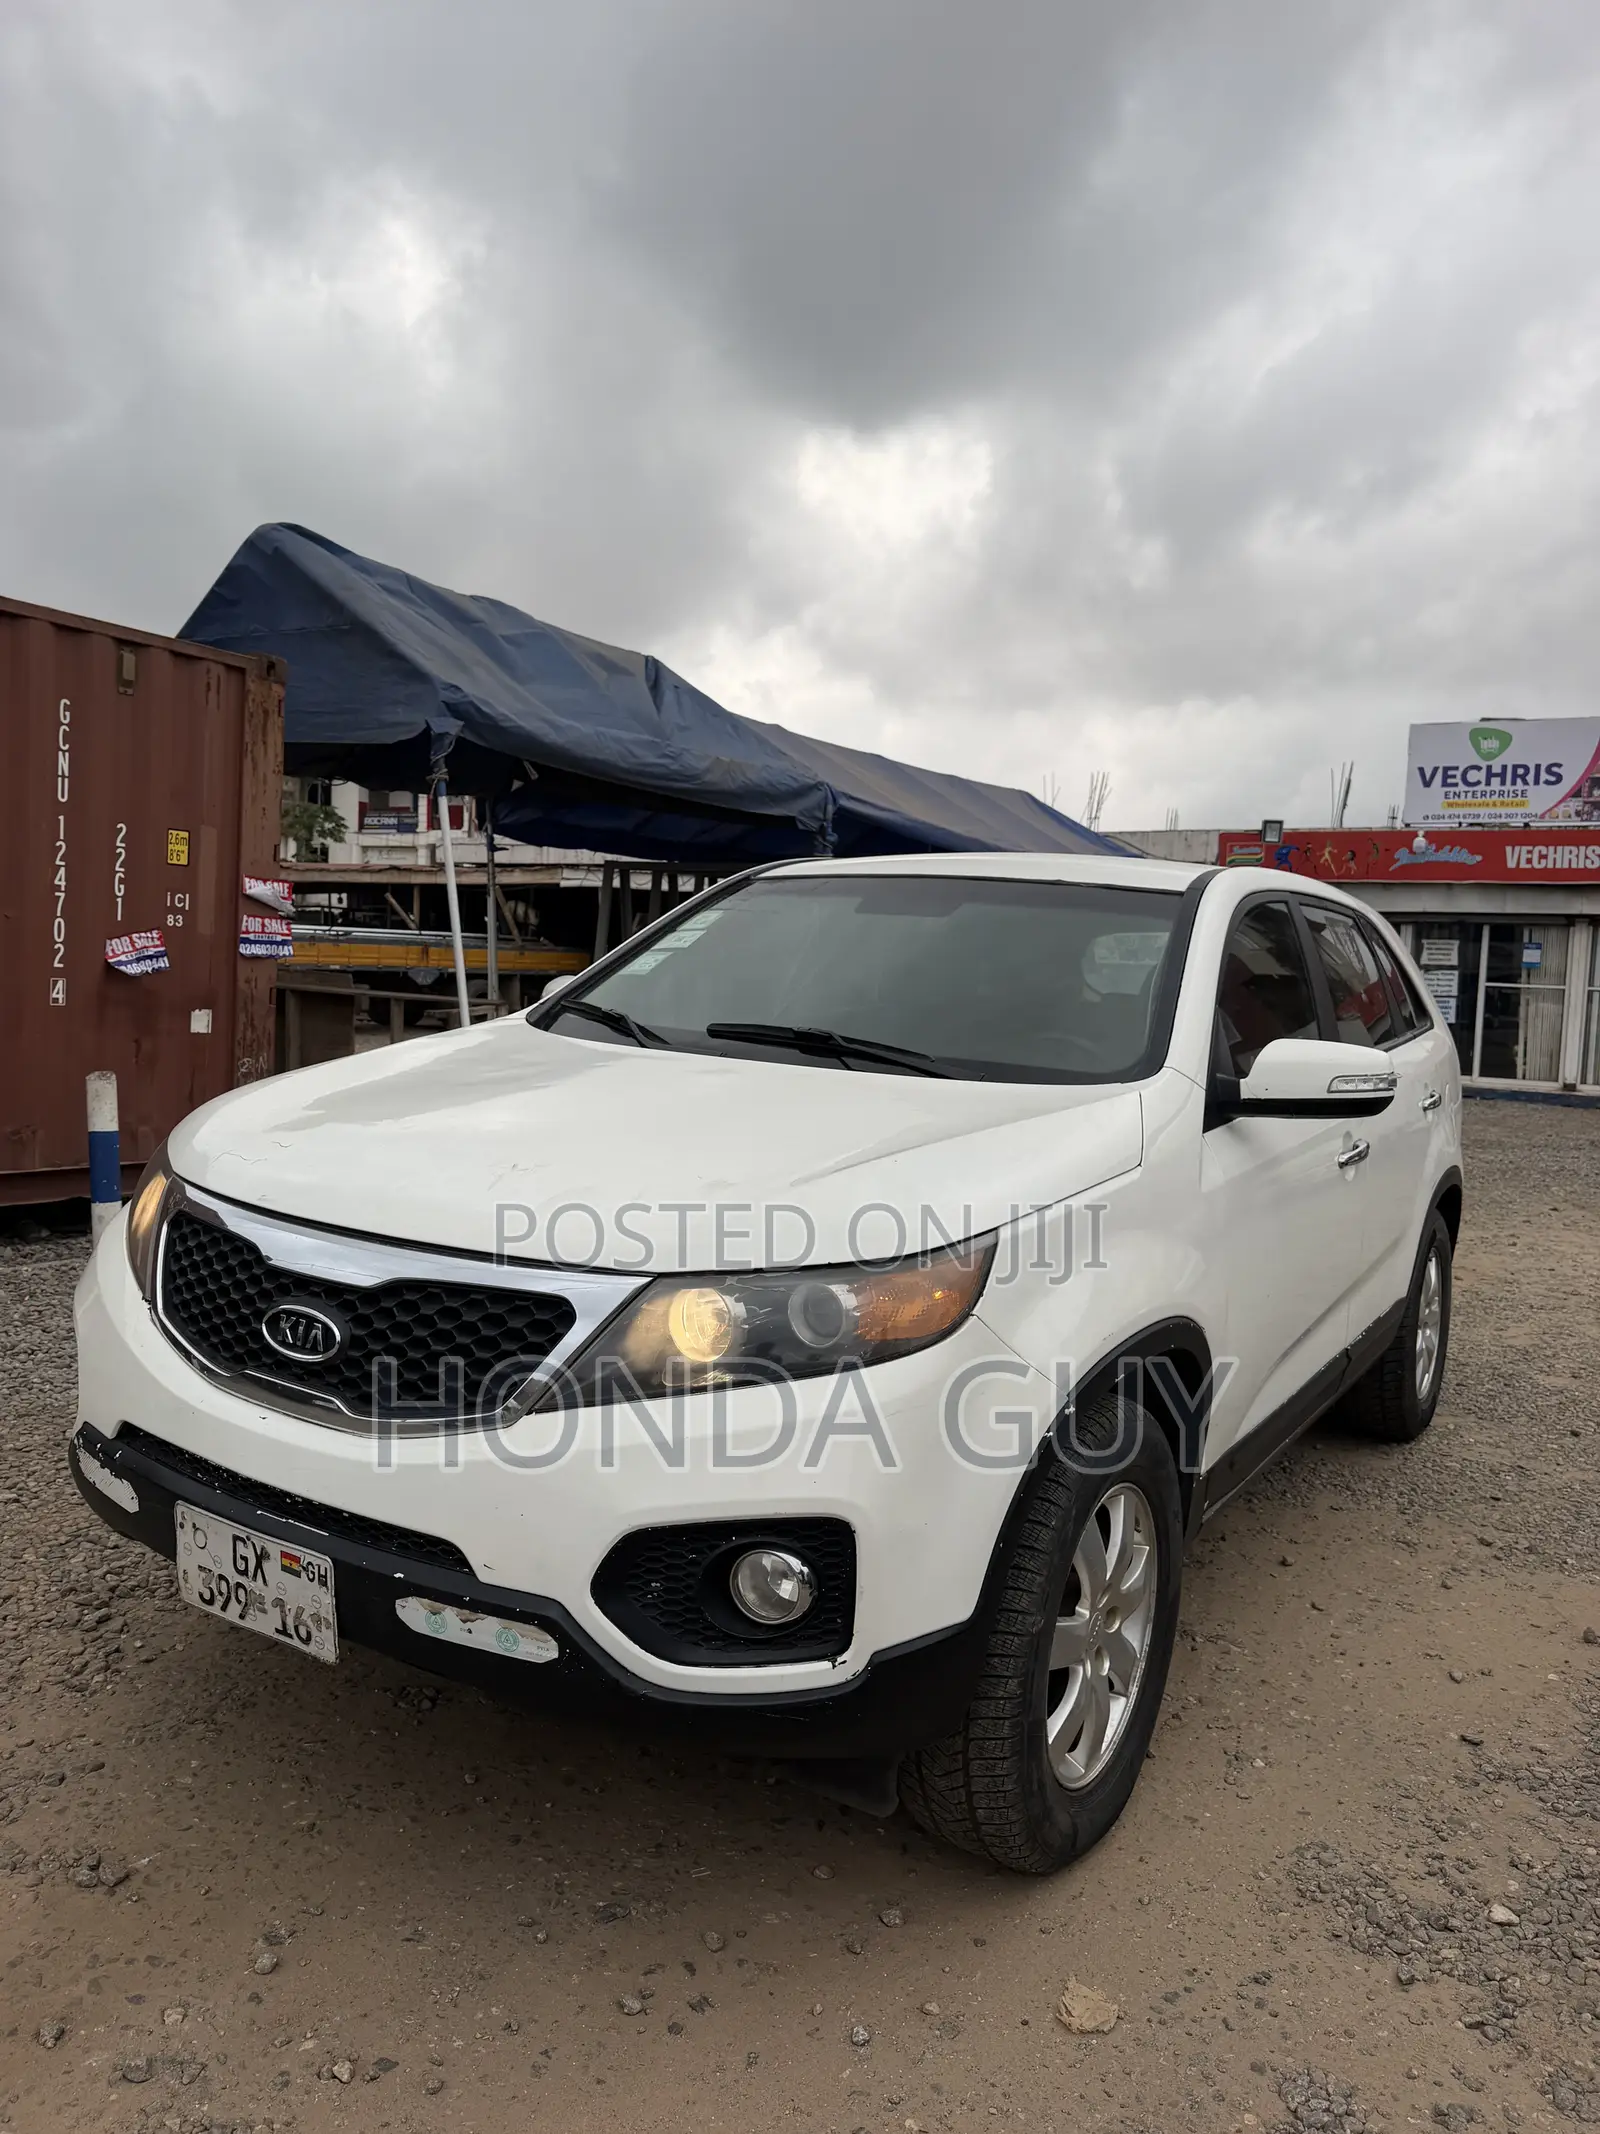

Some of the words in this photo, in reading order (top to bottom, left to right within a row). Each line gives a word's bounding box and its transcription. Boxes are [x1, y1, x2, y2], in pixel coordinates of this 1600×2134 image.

[57, 698, 71, 803] GCNU
[1417, 762, 1564, 788] VECHRIS
[1444, 789, 1528, 800] ENTERPRISE
[1446, 801, 1491, 809] Wholesale
[1505, 845, 1600, 869] VECHRIS
[114, 822, 127, 922] 22G1
[53, 815, 67, 968] 124702
[166, 914, 183, 927] 83
[241, 914, 263, 932] FOR
[263, 918, 291, 934] SALE
[105, 935, 133, 956] FOR
[132, 929, 160, 949] SALE
[51, 979, 66, 1006] 4
[278, 1314, 324, 1352] KIA
[232, 1533, 269, 1587] GX
[305, 1560, 330, 1593] GH
